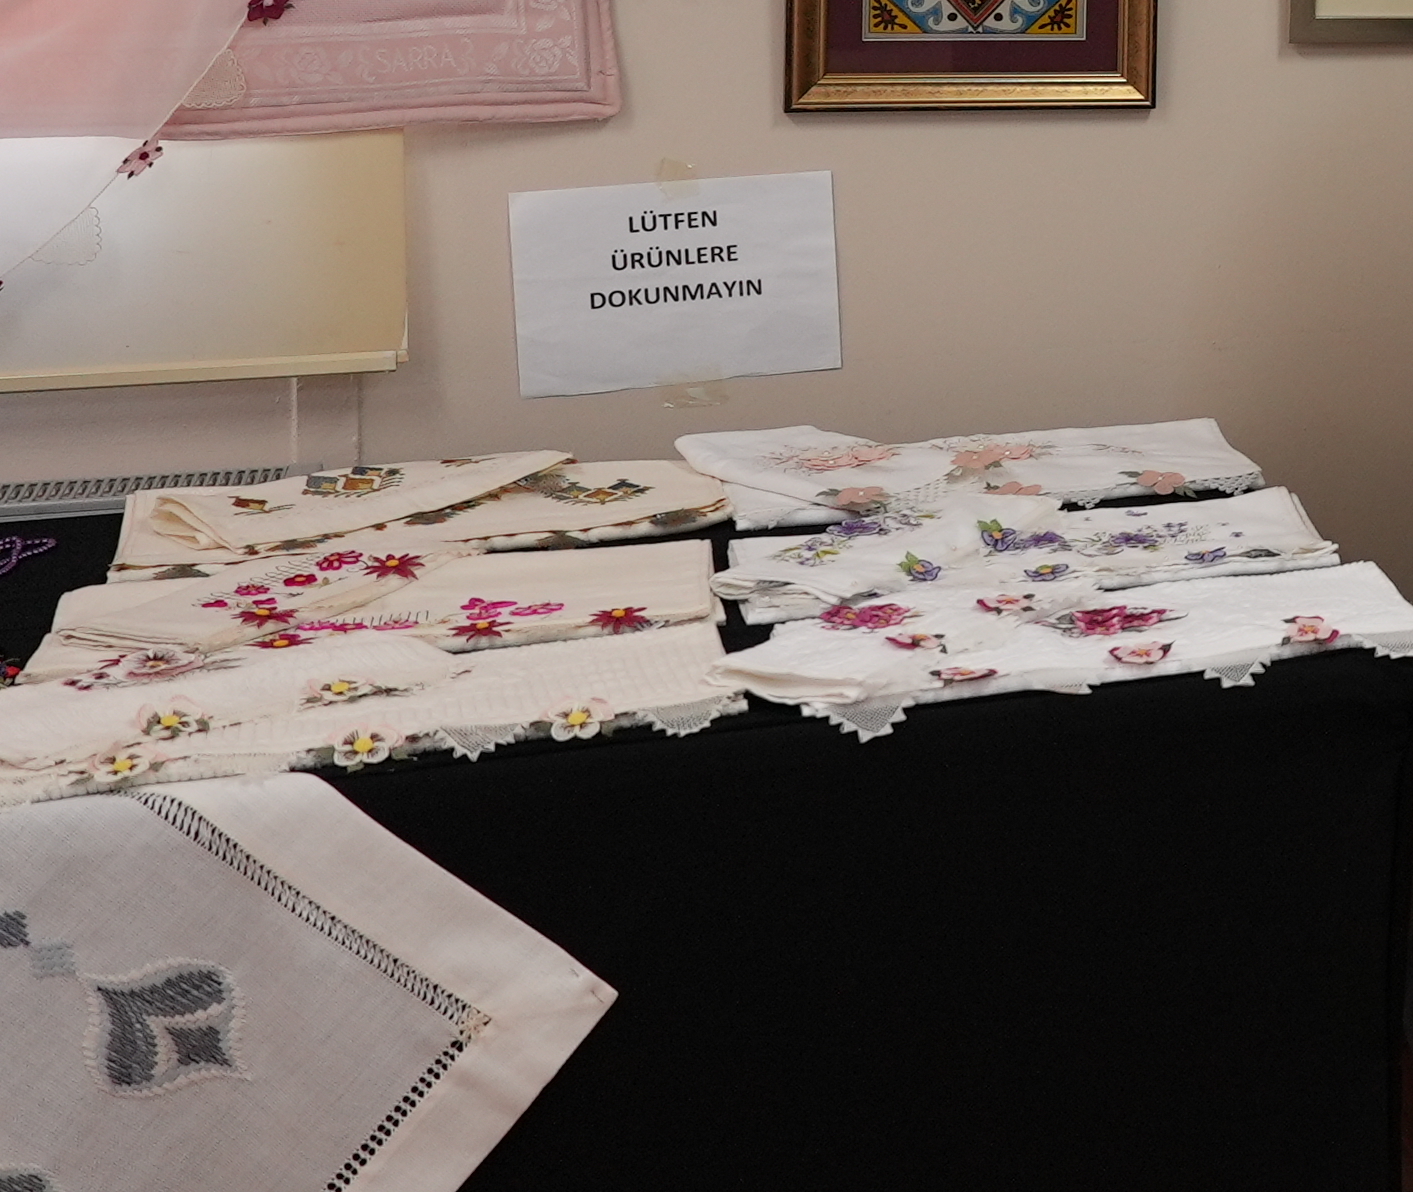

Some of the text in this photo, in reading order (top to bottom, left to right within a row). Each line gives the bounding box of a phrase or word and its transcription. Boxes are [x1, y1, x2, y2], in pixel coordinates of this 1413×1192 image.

[376, 43, 457, 74] SARRA
[628, 210, 718, 234] LÜTFEN
[611, 244, 739, 271] ÜRÜNLERE
[590, 278, 763, 310] DOKUNMAYIN
